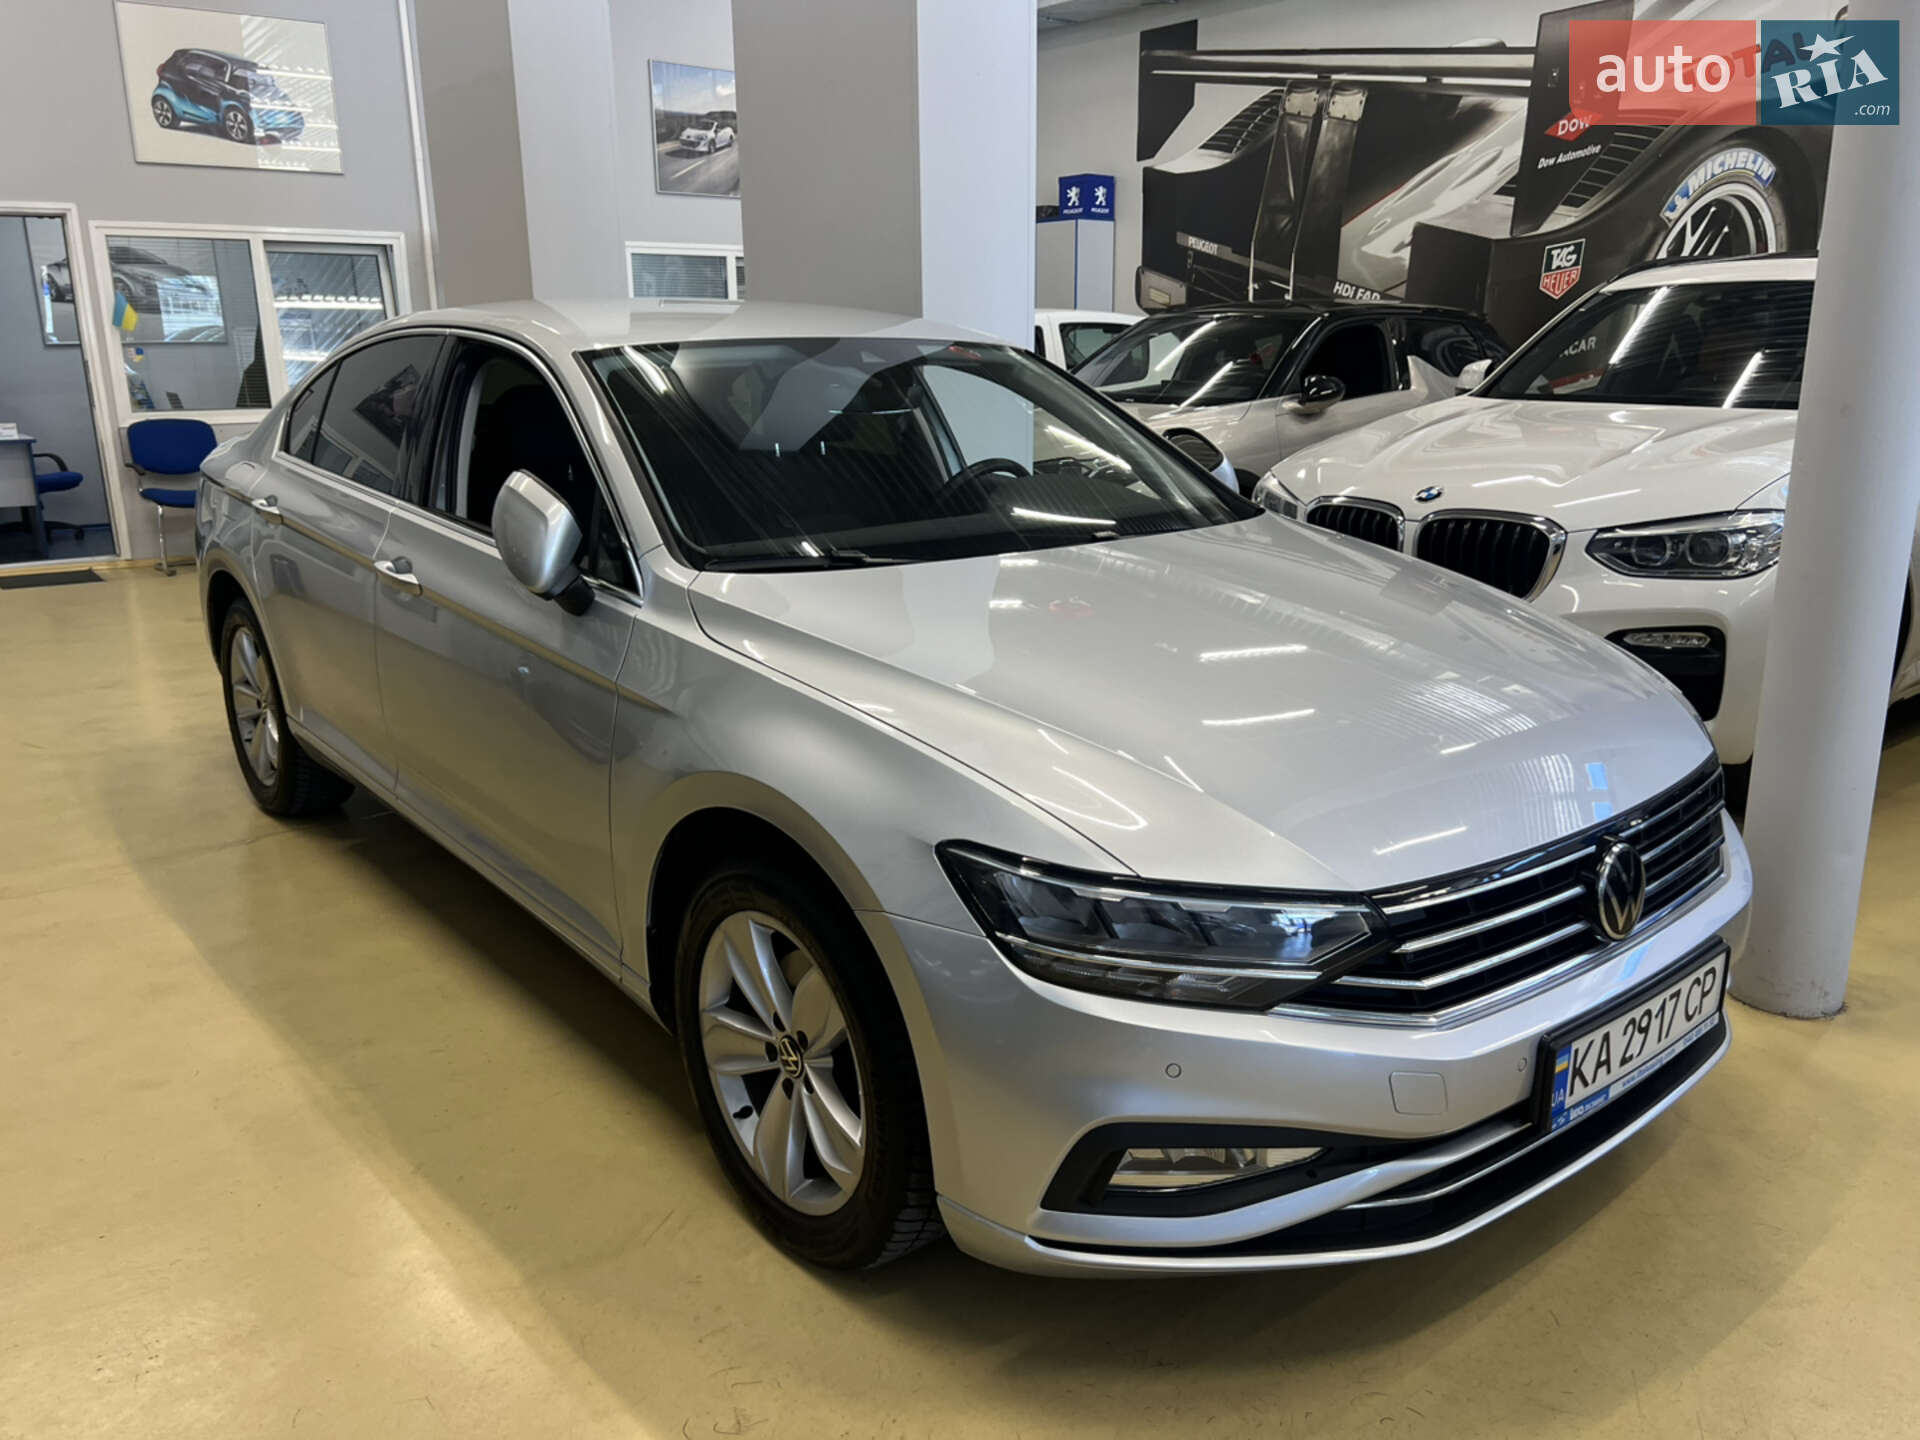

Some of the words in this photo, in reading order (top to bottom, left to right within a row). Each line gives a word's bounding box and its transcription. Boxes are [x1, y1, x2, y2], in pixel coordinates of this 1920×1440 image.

[1537, 157, 1557, 169] Dow
[1556, 144, 1602, 165] Automotive
[1686, 151, 1774, 196] MICHELIN
[1551, 245, 1577, 270] TAG
[1542, 270, 1578, 295] HEUER
[1569, 1031, 1612, 1097] KA
[1619, 988, 1682, 1068] 2917
[1684, 966, 1717, 1022] CP
